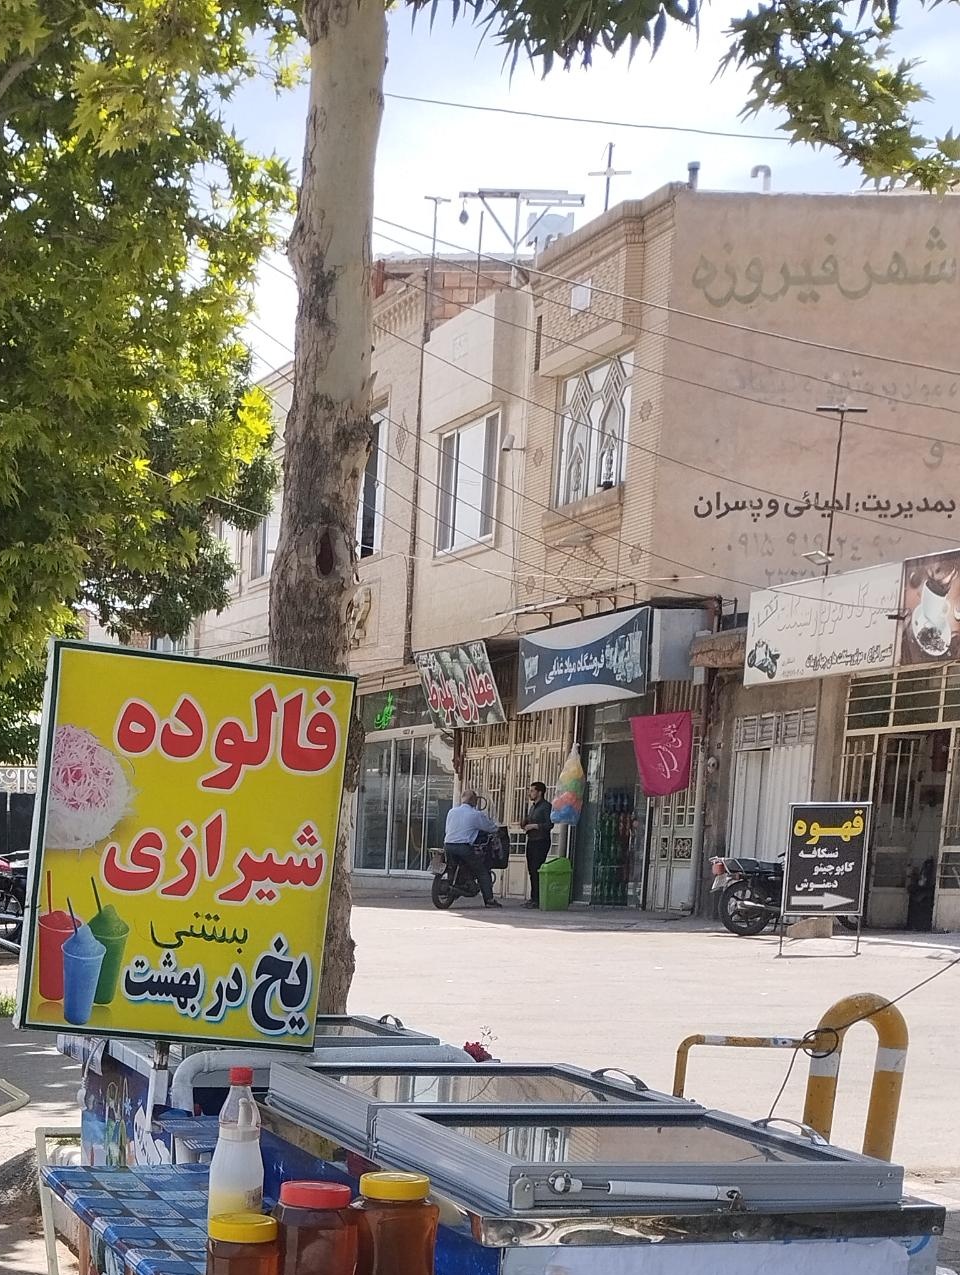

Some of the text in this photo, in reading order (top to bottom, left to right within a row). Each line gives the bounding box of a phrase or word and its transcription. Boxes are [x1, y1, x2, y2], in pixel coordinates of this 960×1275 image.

[692, 232, 839, 308] فیروزه
[692, 491, 763, 523] پسران
[764, 501, 780, 518] و
[564, 655, 577, 681] مواد
[576, 649, 605, 677] فروشگاه
[458, 662, 497, 724] عطاری
[116, 685, 337, 791] فالوده
[793, 808, 864, 845] قهوه
[103, 812, 324, 903] شیرازی
[798, 847, 839, 859] نسکافه
[794, 878, 839, 892] دمنوش
[123, 936, 309, 1032] یخ در بهشت
